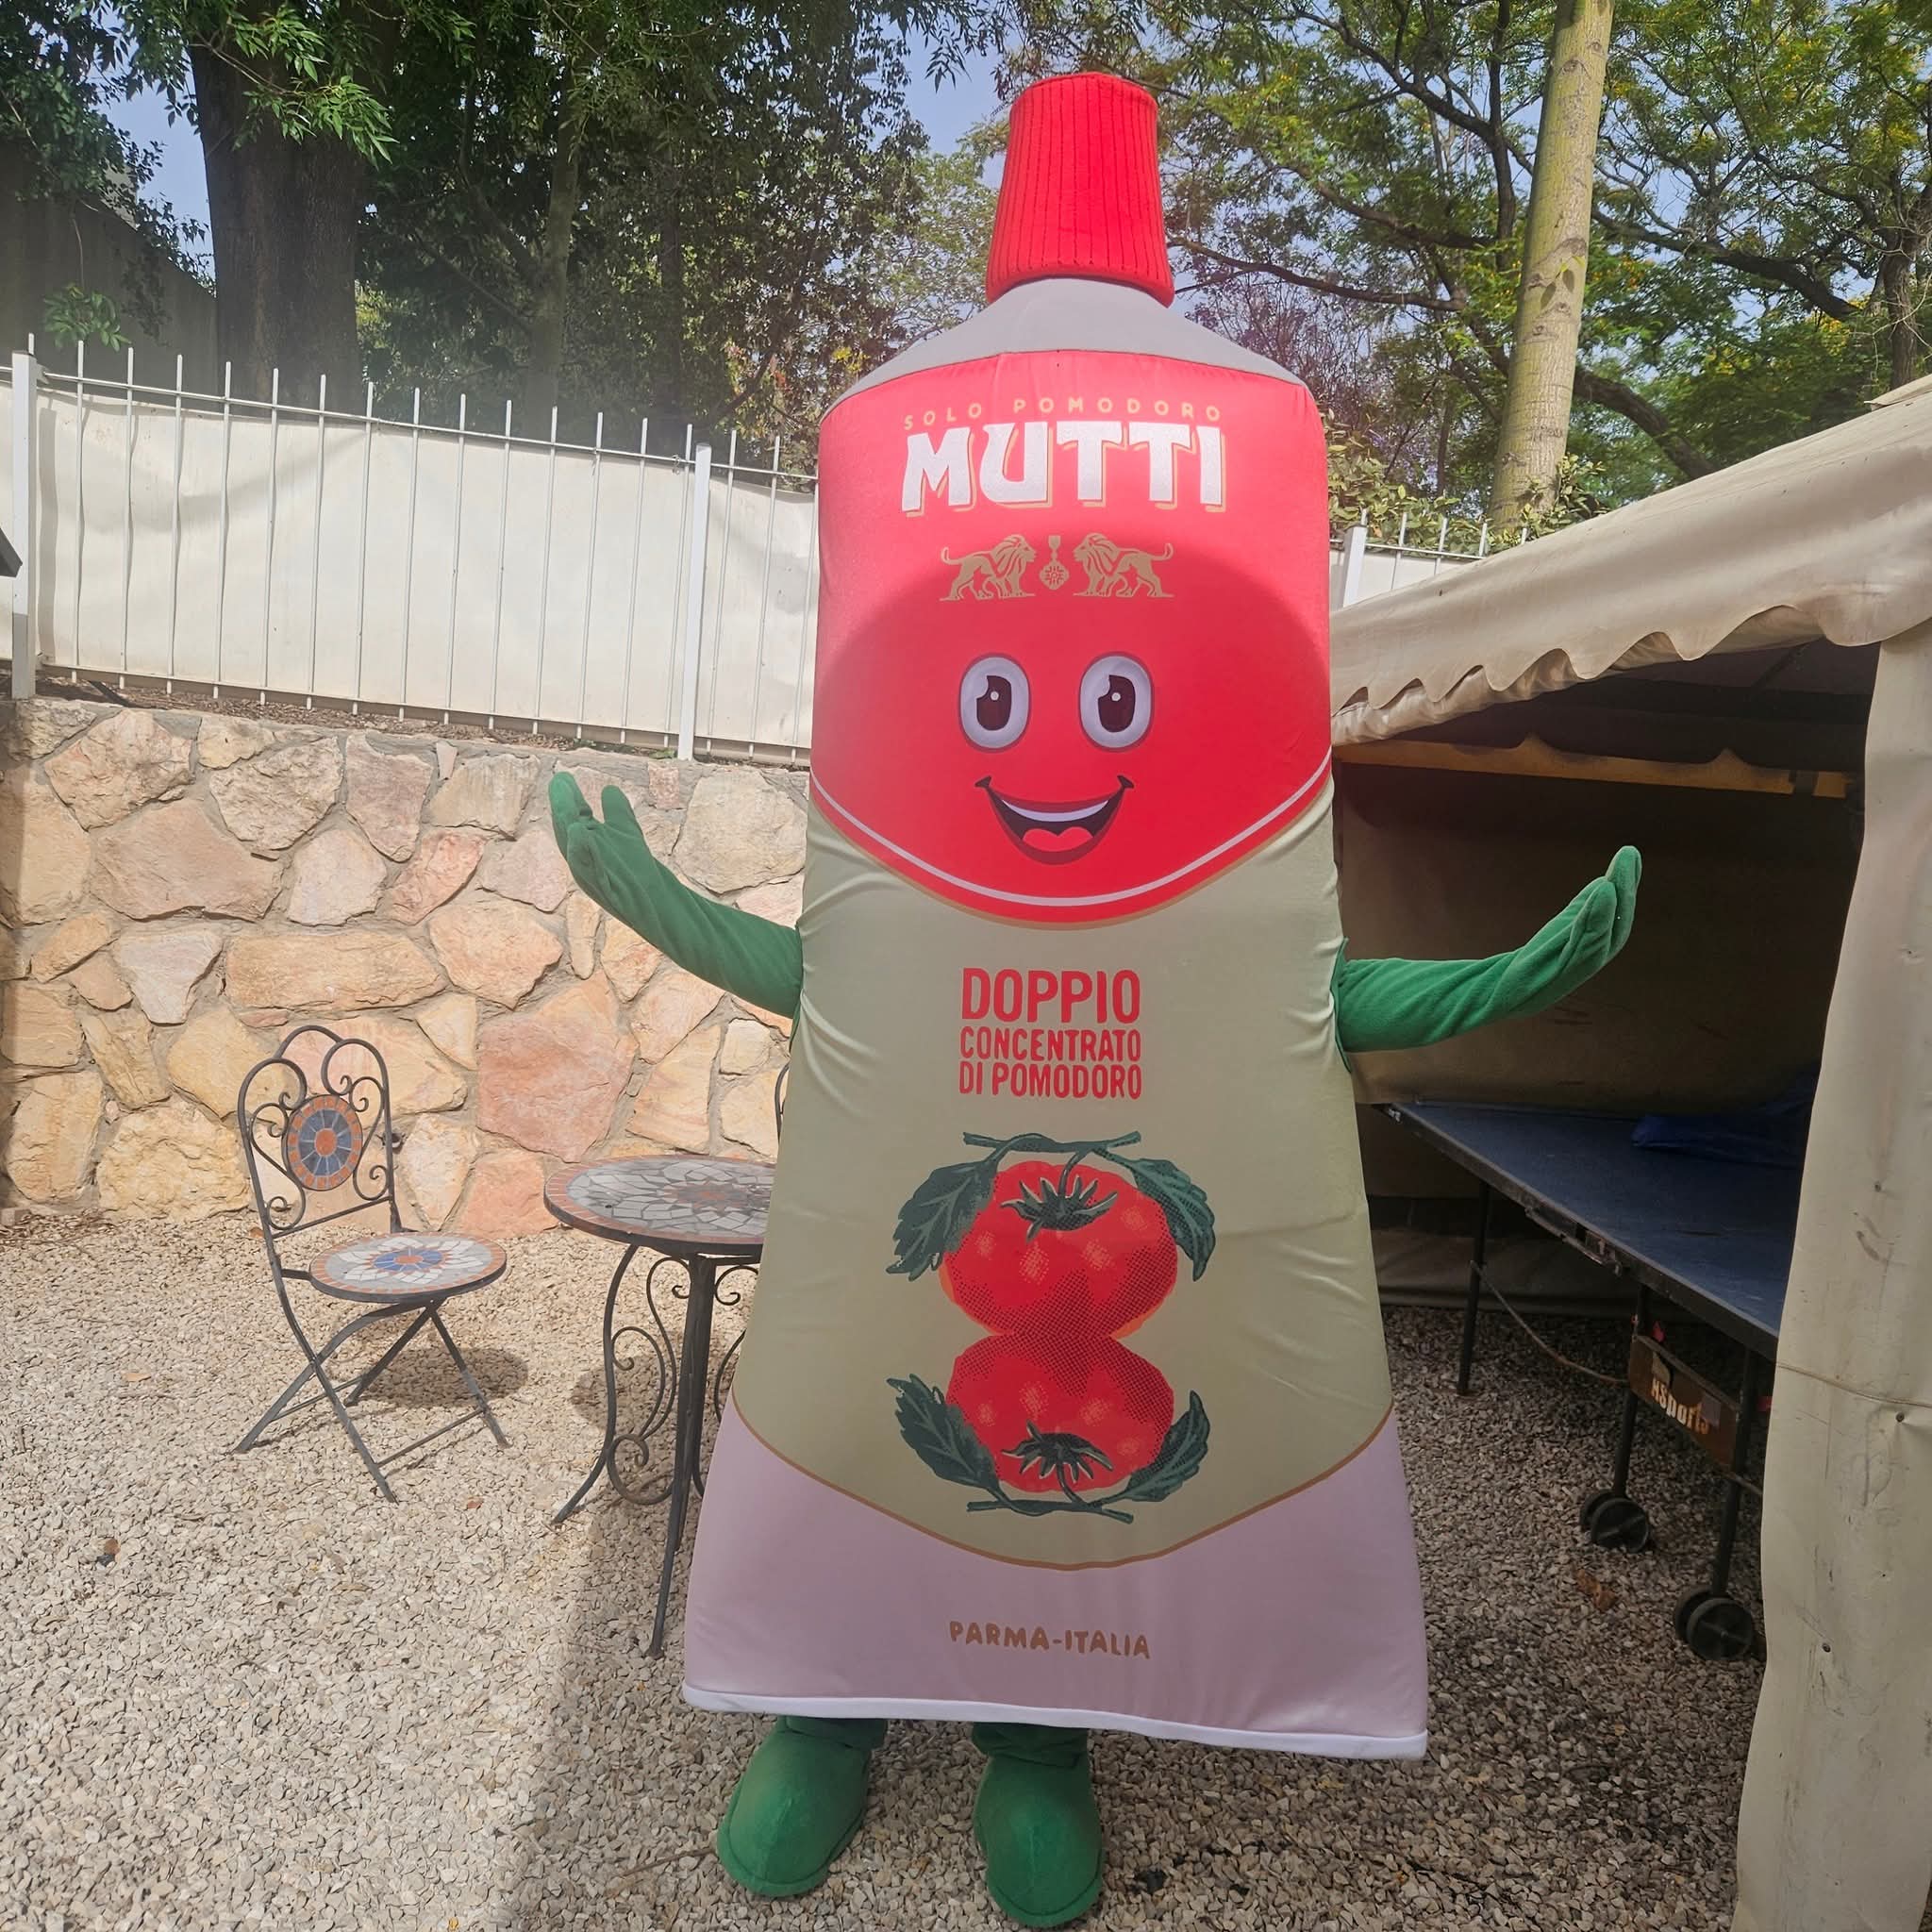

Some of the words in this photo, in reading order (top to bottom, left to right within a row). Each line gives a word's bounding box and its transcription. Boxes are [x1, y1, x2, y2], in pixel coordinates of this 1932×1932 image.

[904, 403, 982, 430] SOLO
[1013, 397, 1221, 422] POMODORO
[901, 421, 1226, 517] MUTTI
[961, 967, 1141, 1024] DOPPIO
[959, 1025, 1141, 1061] CONCENTRATO
[958, 1061, 983, 1094] DI
[991, 1062, 1141, 1100] POMODORO
[949, 1621, 1151, 1659] PARMA-ITALIA
